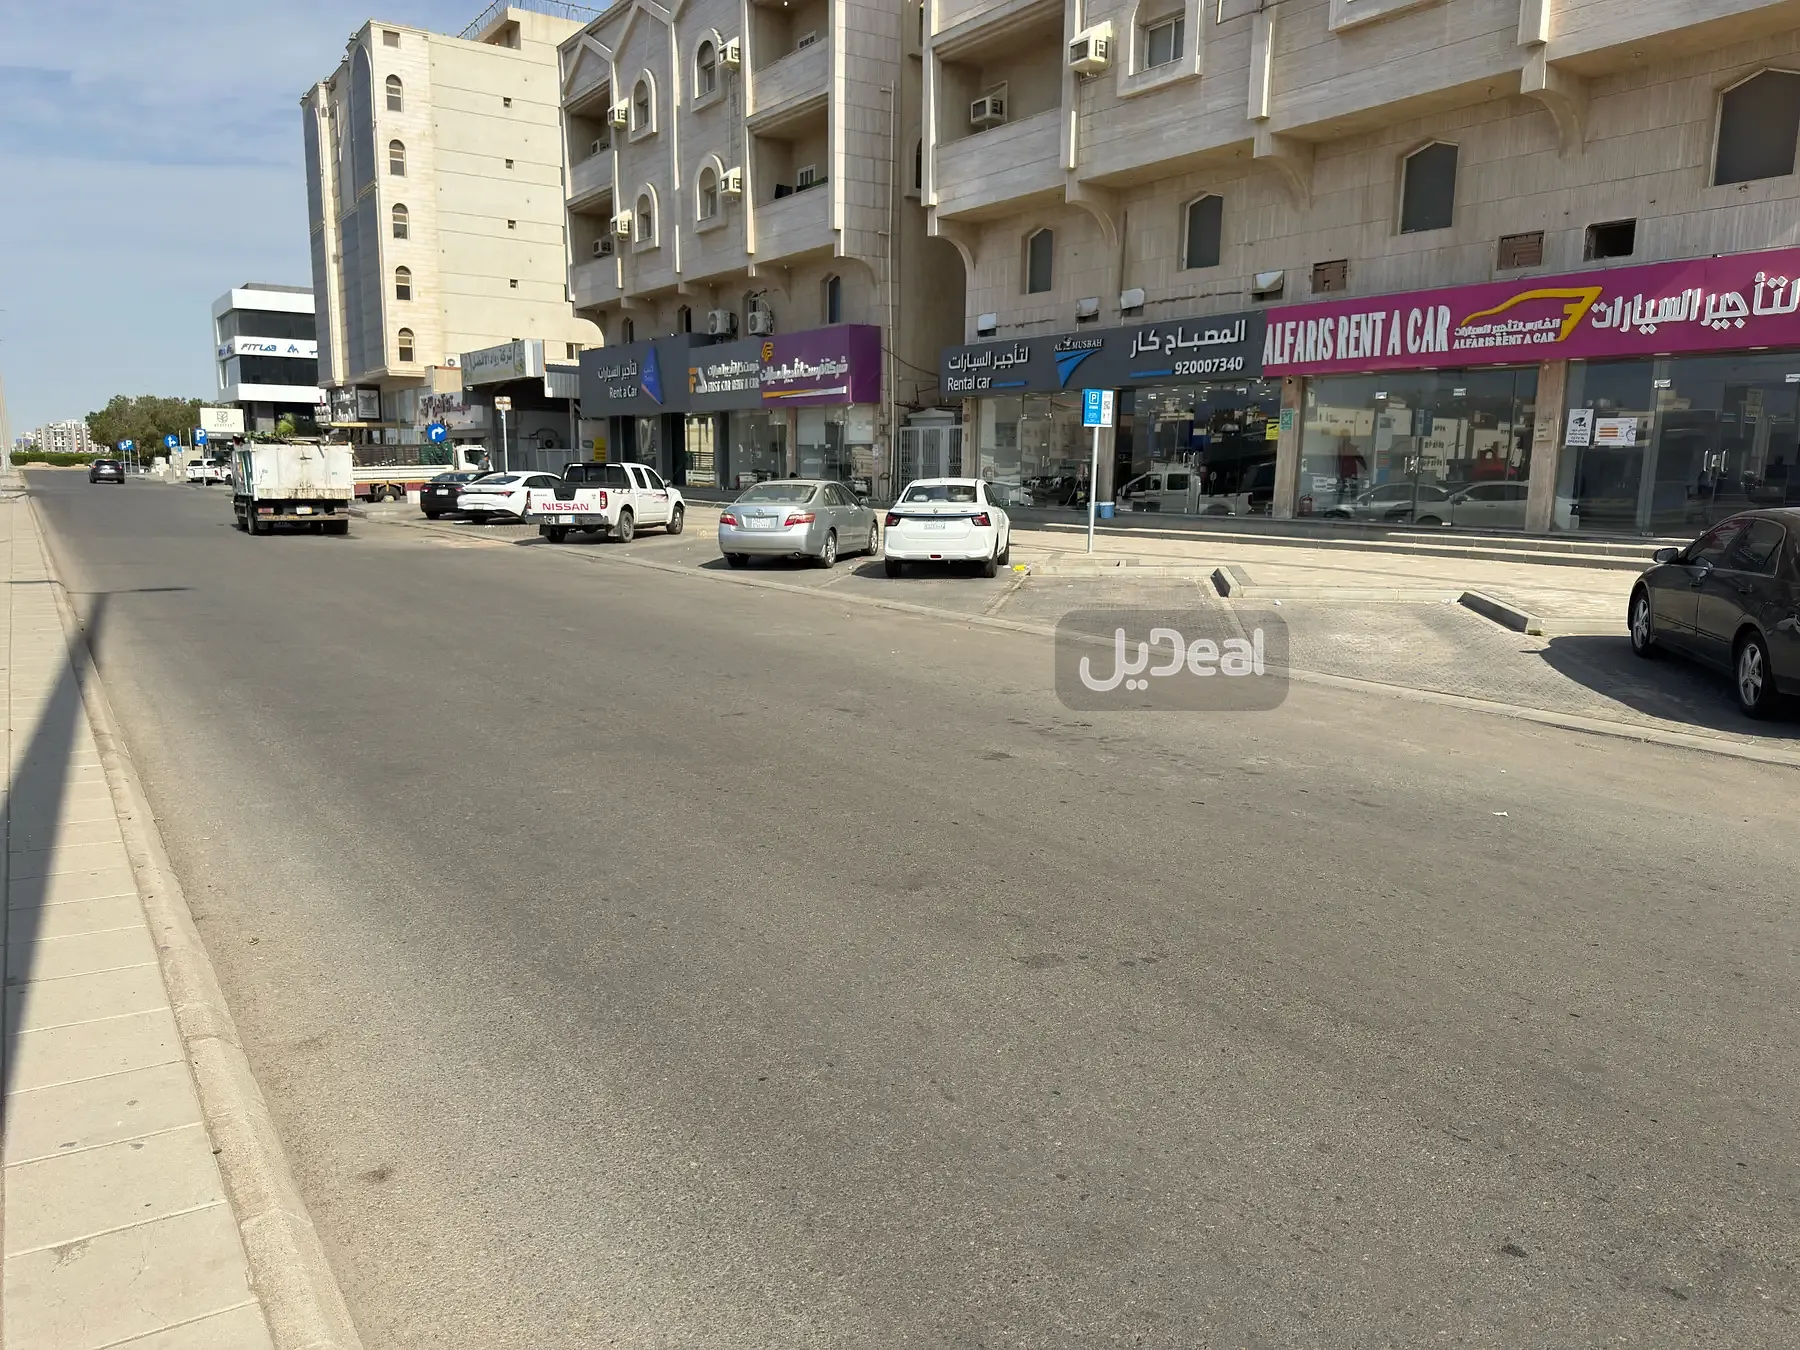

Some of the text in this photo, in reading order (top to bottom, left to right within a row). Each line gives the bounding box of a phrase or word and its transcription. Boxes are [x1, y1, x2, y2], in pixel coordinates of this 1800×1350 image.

[1591, 271, 1800, 335] لتأجير السيارات
[1130, 319, 1246, 358] المصباح كار
[1262, 305, 1450, 366] ALFARIS RENT A CAR
[1453, 332, 1556, 350] ALFARIS RENT A CAR
[1053, 338, 1103, 352] AL MUSBAH
[948, 343, 1029, 372] لتأجير السيارات
[1174, 356, 1243, 375] 920007340
[598, 365, 621, 382] السيارات
[621, 358, 637, 380] لتأجير
[824, 355, 848, 380] شركة
[609, 385, 638, 399] Rent a Car
[947, 376, 992, 392] Rental car
[196, 429, 205, 441] P
[542, 503, 589, 511] NISSAN
